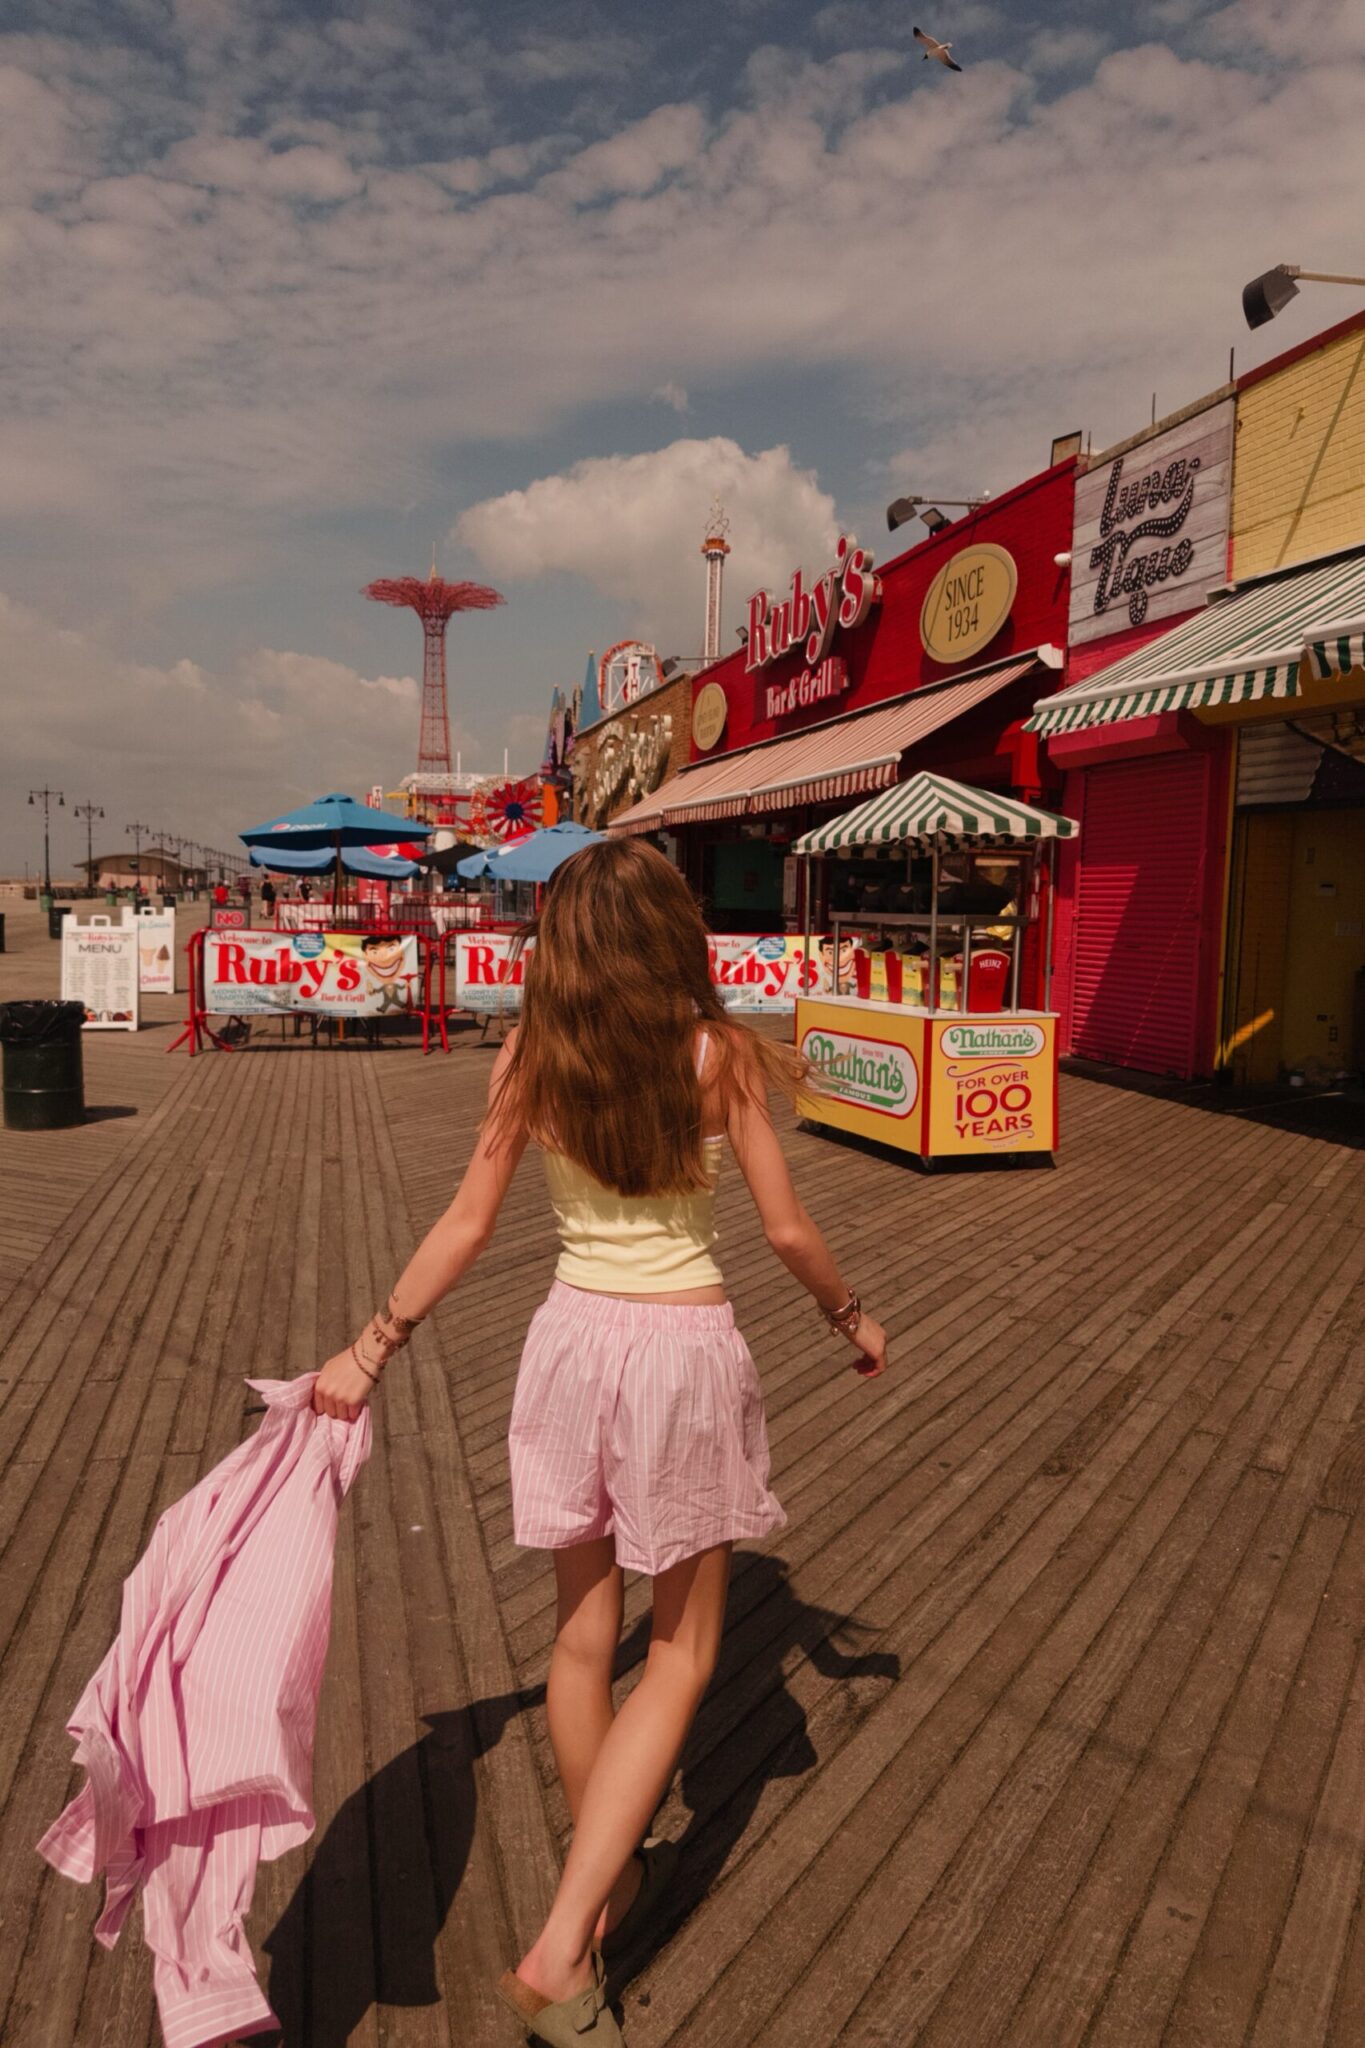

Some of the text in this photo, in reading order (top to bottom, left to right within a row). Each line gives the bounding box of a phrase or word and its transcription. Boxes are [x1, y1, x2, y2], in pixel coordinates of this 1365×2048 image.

[1100, 458, 1190, 539] Luna
[945, 565, 985, 611] SINCE
[1089, 522, 1195, 626] Tique
[745, 534, 870, 674] Ruby's
[947, 602, 979, 642] 1934
[215, 910, 244, 927] NO
[78, 943, 122, 954] MENU
[979, 959, 1002, 969] HEINZ
[211, 942, 362, 998] Ruby's
[949, 1027, 1035, 1049] Nathan's
[809, 1034, 905, 1094] Nathan's
[956, 1070, 1029, 1091] FOR OVER
[839, 1087, 872, 1101] FAMOUS
[956, 1084, 1032, 1121] 100
[954, 1113, 1033, 1139] YEARS
